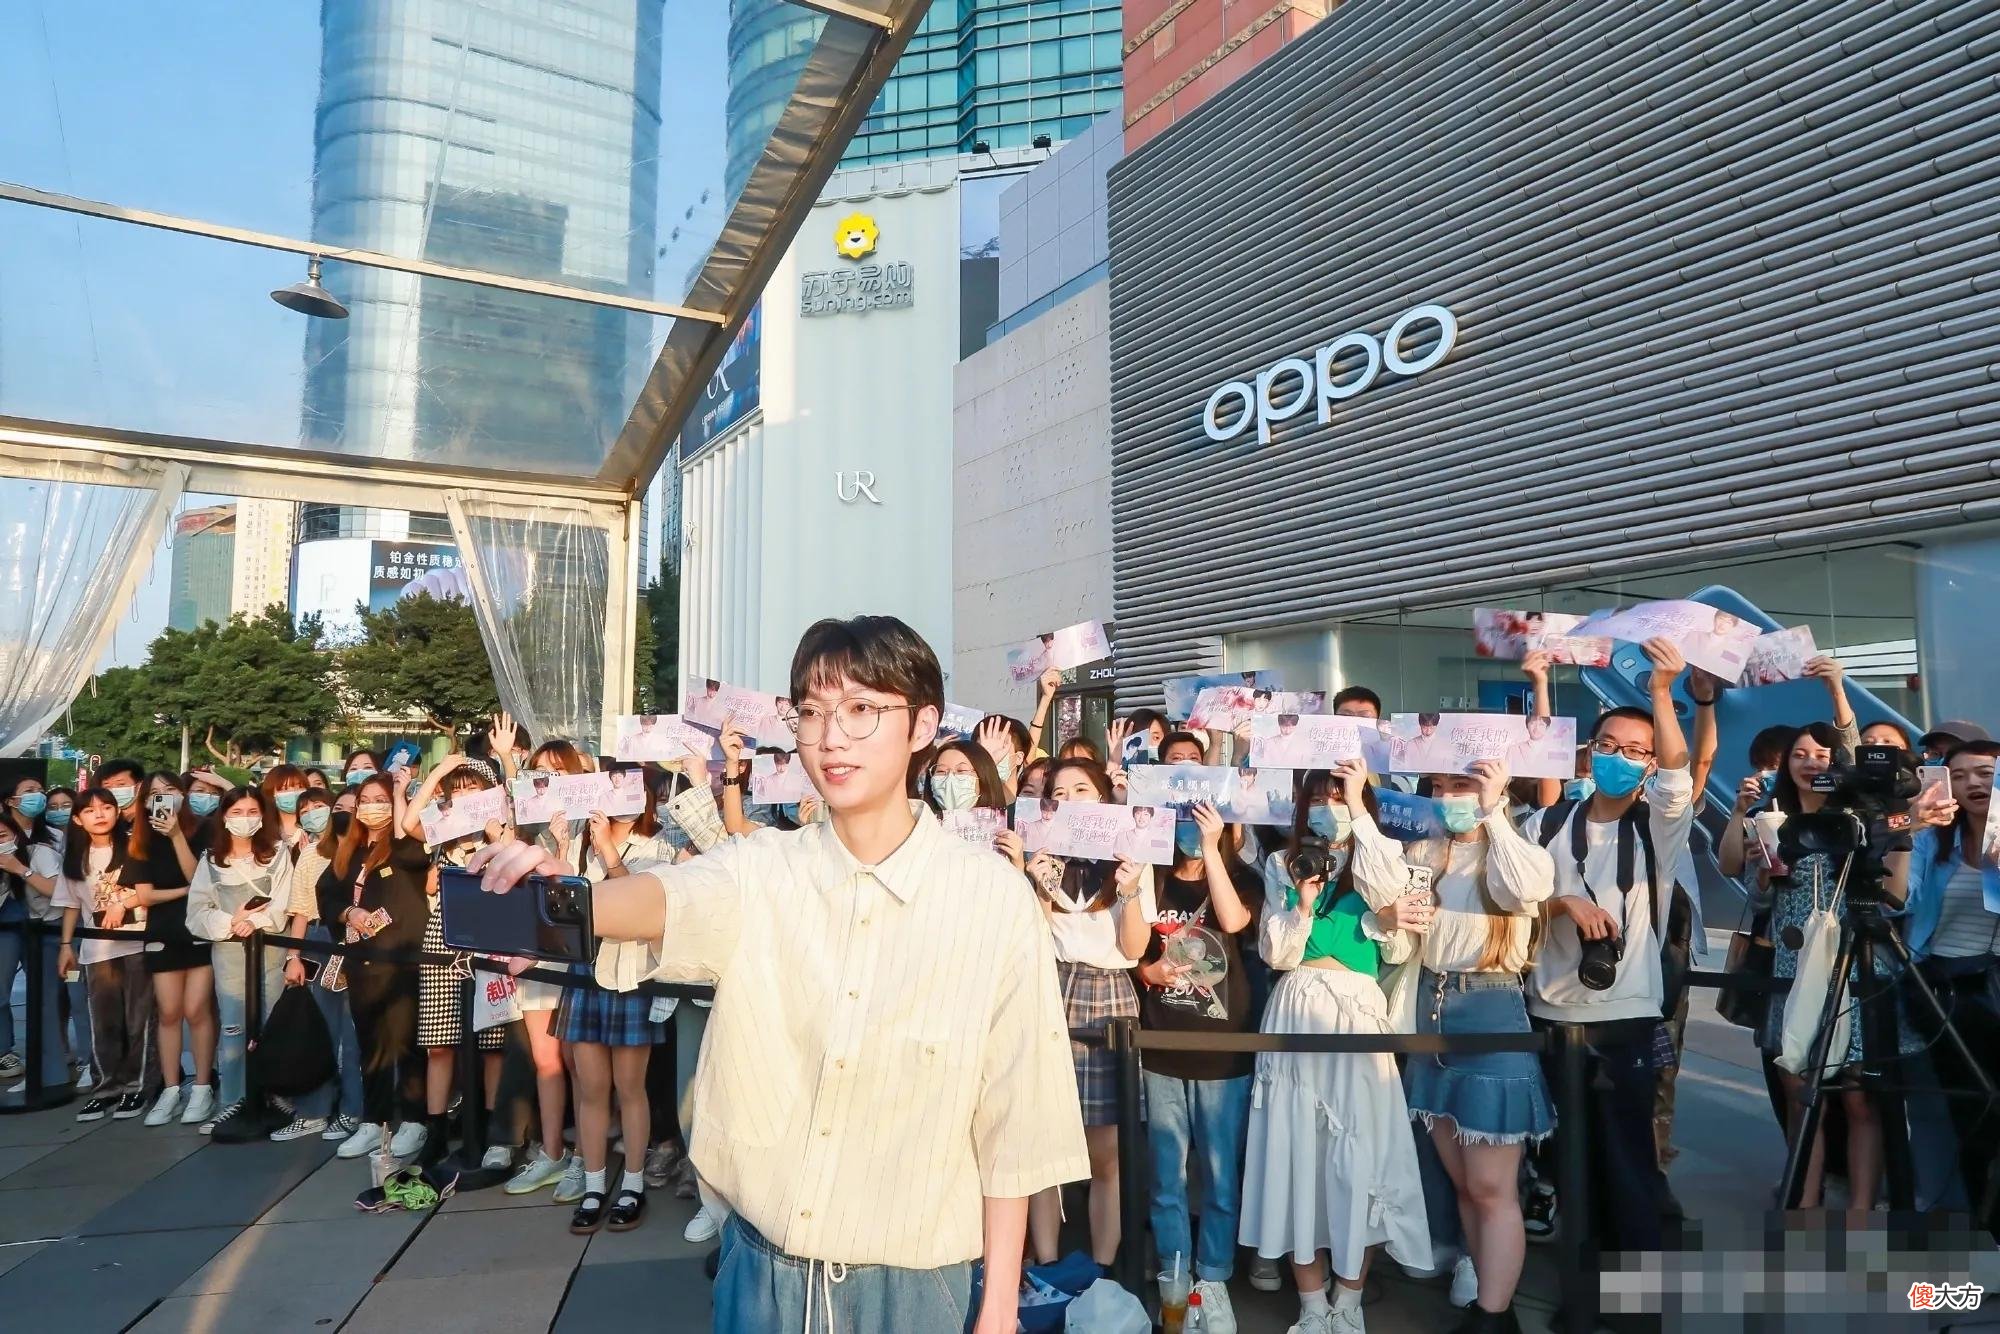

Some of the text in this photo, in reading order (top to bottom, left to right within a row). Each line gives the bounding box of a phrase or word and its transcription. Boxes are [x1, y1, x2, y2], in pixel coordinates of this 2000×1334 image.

[801, 292, 914, 316] suning.com
[1203, 304, 1458, 445] oppo
[834, 470, 885, 505] UR
[373, 566, 425, 581] 质感如初
[1089, 667, 1117, 680] ZHOU
[1449, 727, 1509, 744] 你是我的
[1867, 752, 1886, 760] HD
